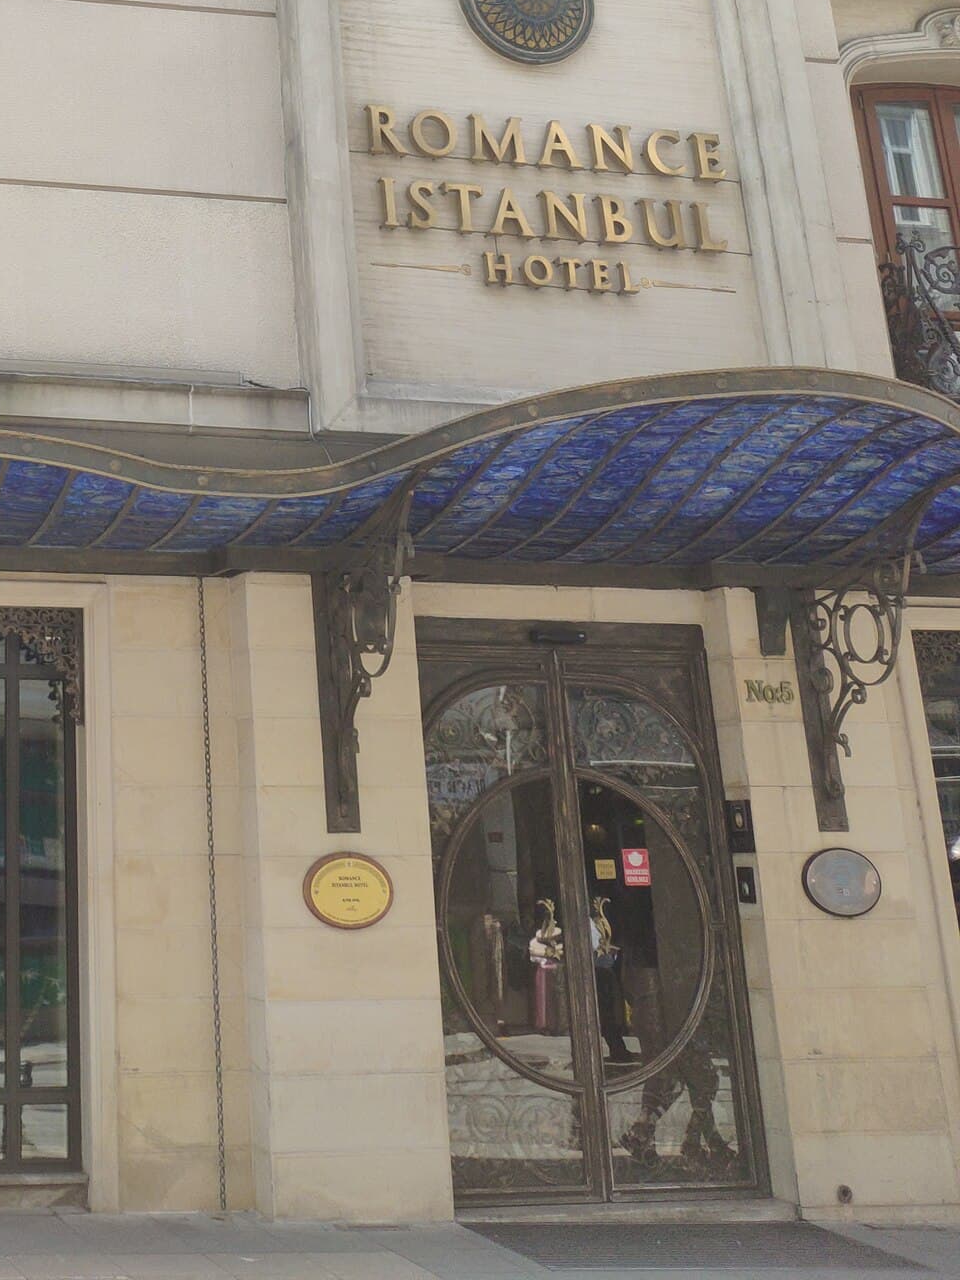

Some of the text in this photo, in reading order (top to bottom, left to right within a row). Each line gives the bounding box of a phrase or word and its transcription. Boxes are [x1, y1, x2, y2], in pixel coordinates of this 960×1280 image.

[364, 104, 727, 181] ROMANCE
[378, 176, 729, 252] ISTANBUL
[483, 251, 640, 295] HOTEL
